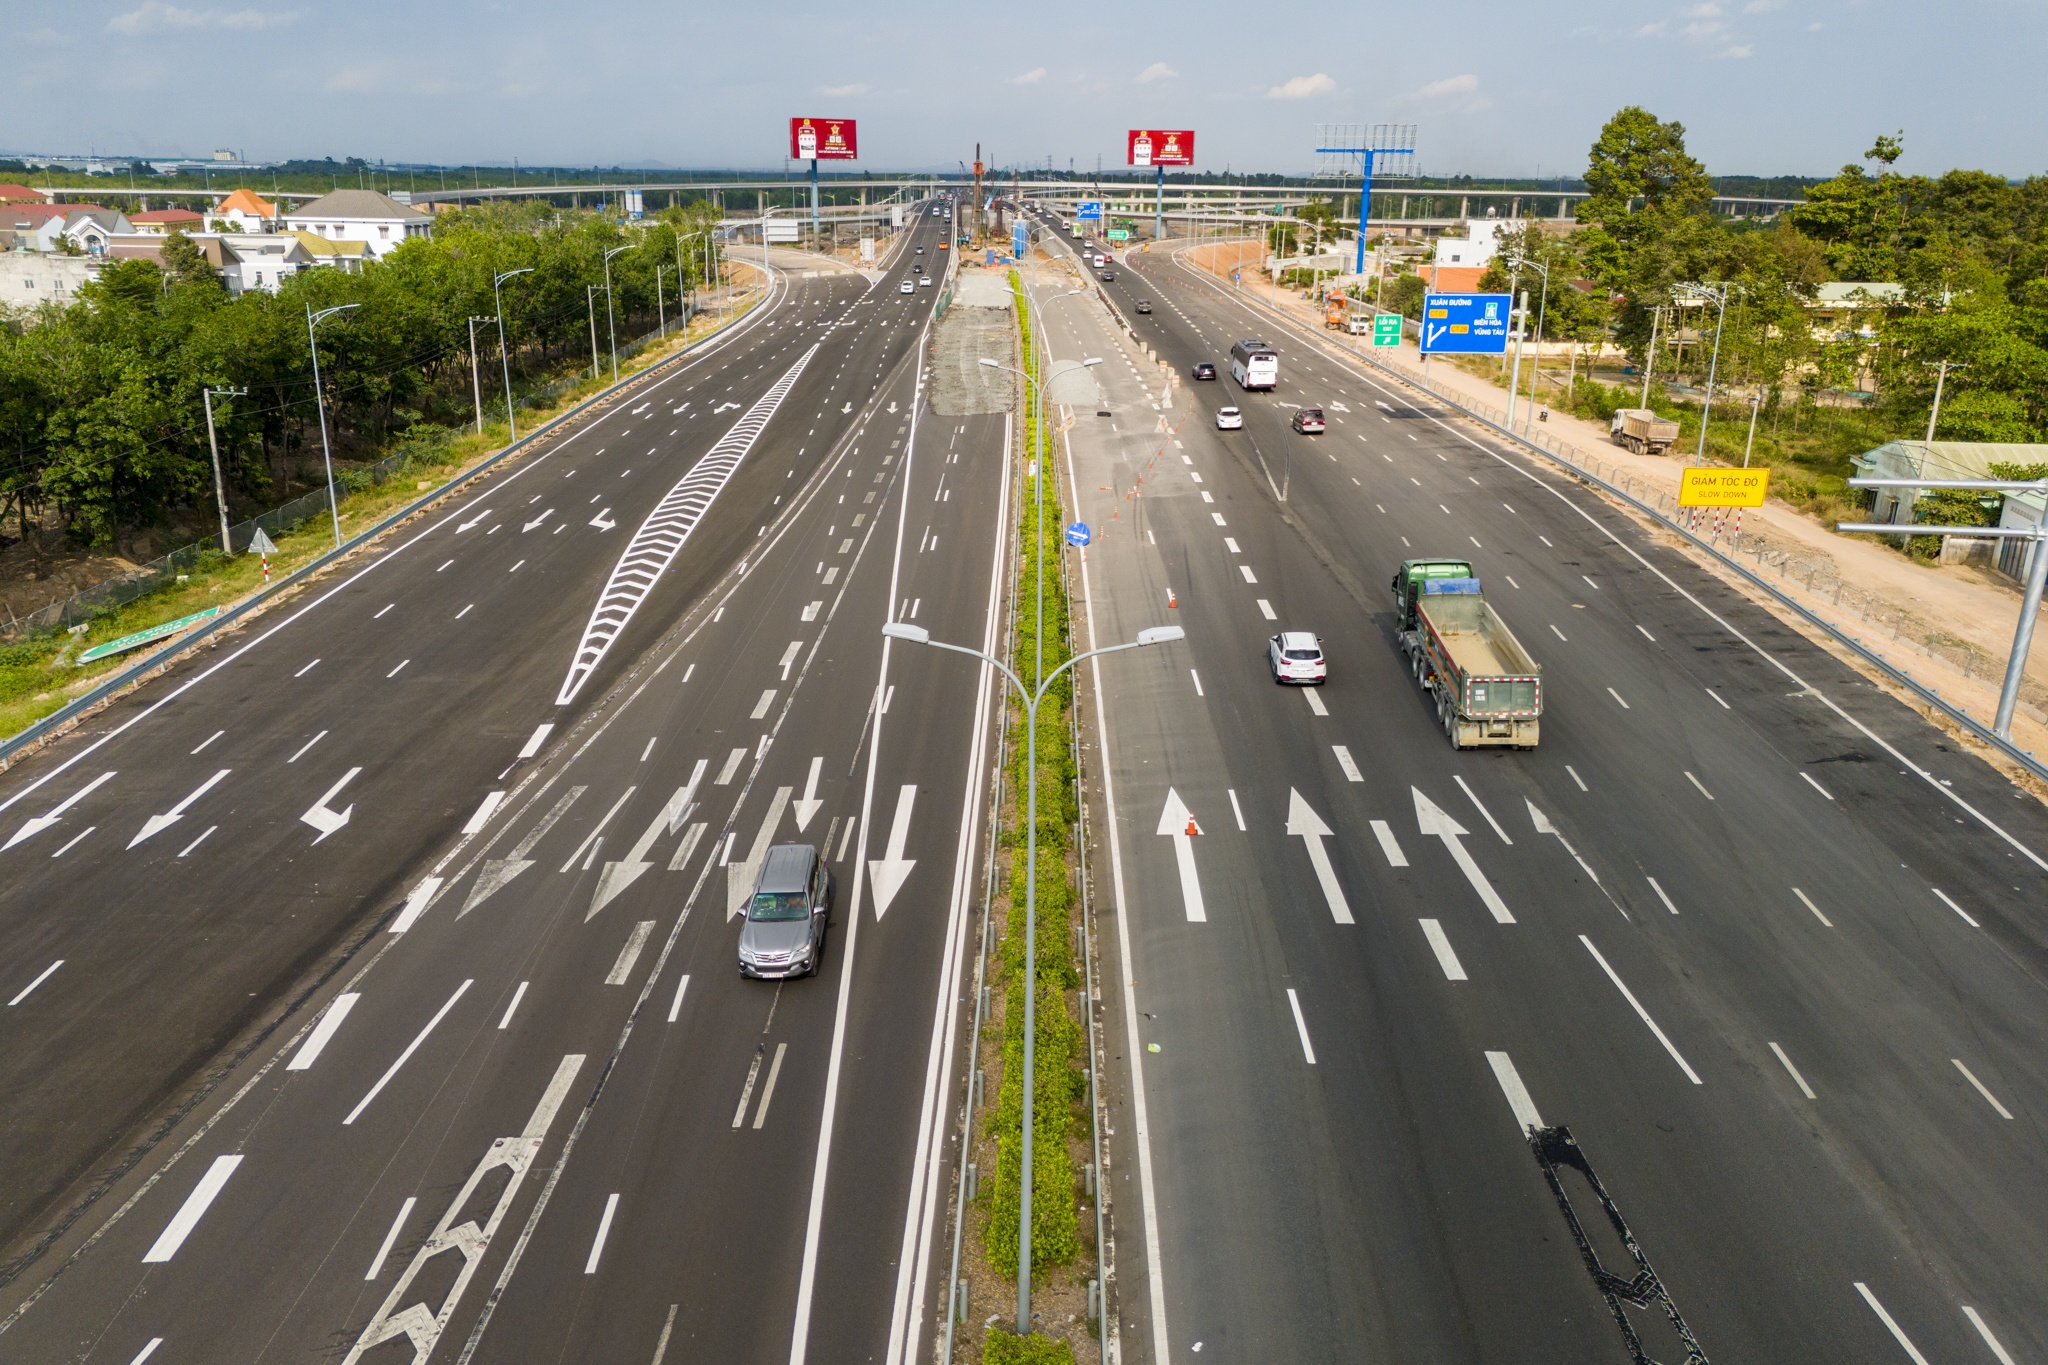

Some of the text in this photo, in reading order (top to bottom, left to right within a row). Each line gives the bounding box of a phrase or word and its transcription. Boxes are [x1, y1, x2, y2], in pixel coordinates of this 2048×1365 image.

[1430, 298, 1448, 306] XUÂN
[1473, 318, 1488, 326] BIÊN
[1474, 327, 1505, 335] VŨNG TÀU
[1691, 472, 1759, 489] GIẢM TỐC ĐỘ
[1698, 490, 1747, 499] SLOW DOWN
